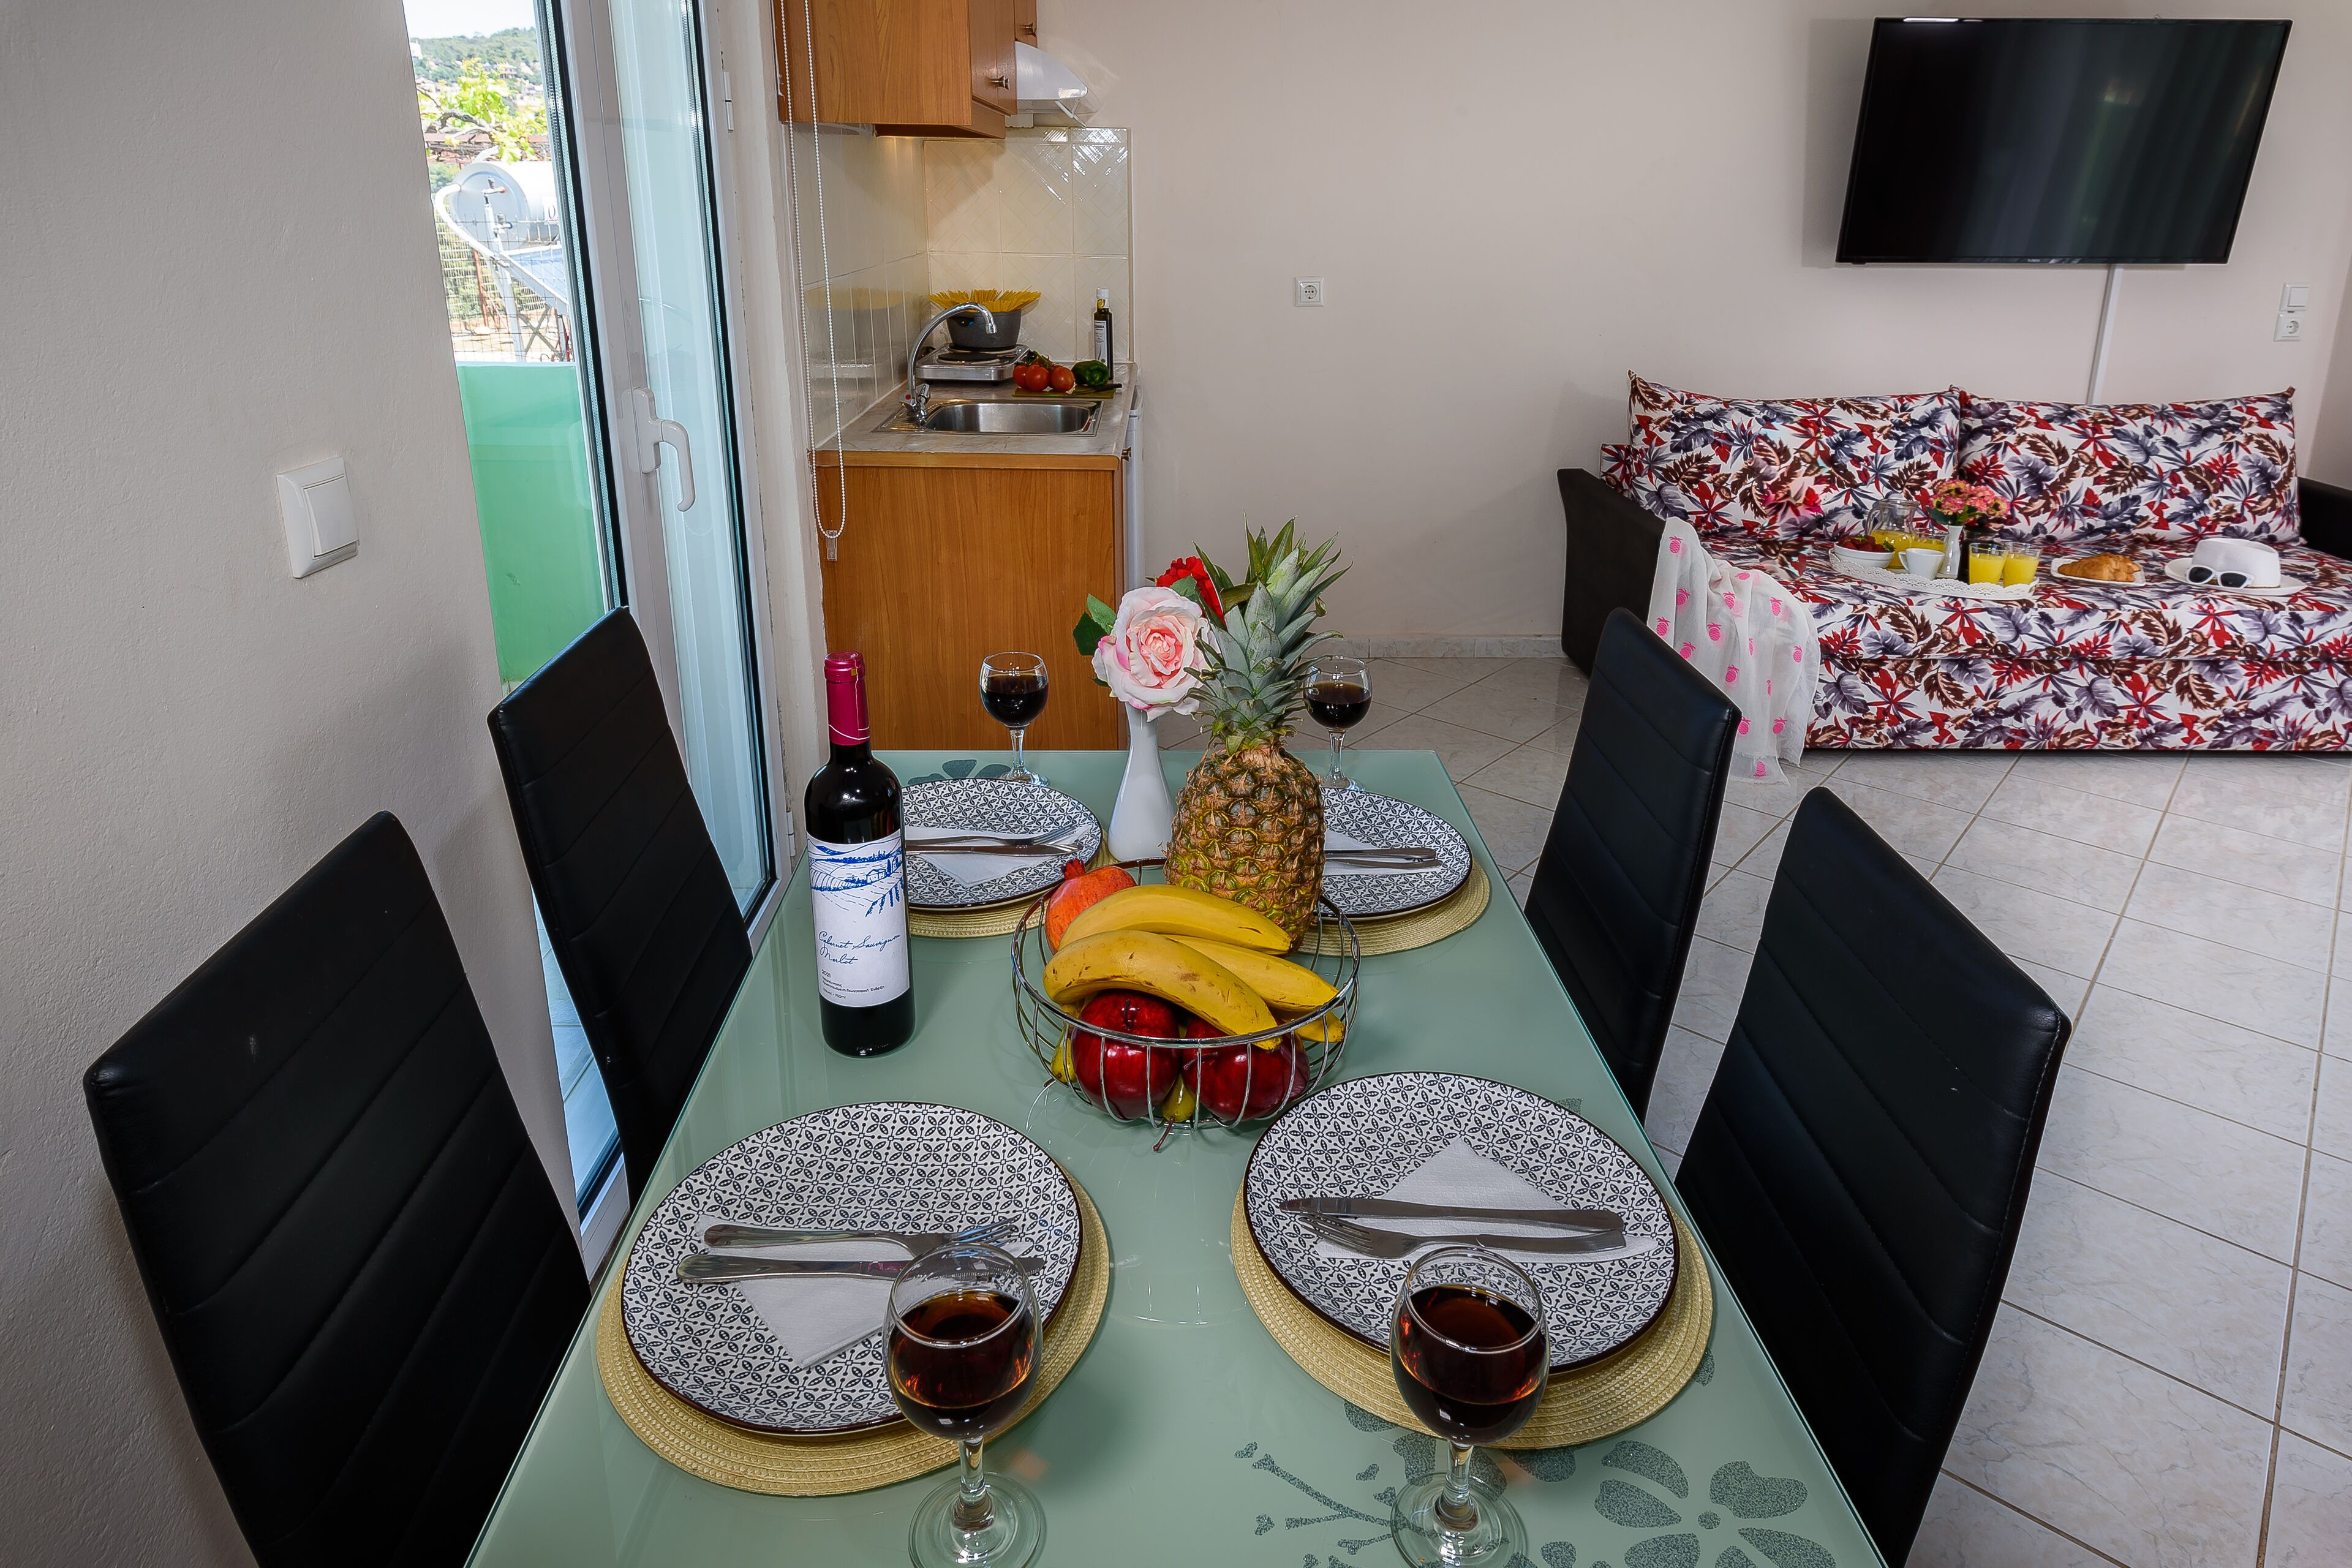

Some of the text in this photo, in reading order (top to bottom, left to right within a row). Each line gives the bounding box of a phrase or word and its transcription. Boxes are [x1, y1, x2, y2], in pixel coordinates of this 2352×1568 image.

[819, 931, 901, 952] Cabernet Sauvignon
[820, 944, 858, 965] Merlot
